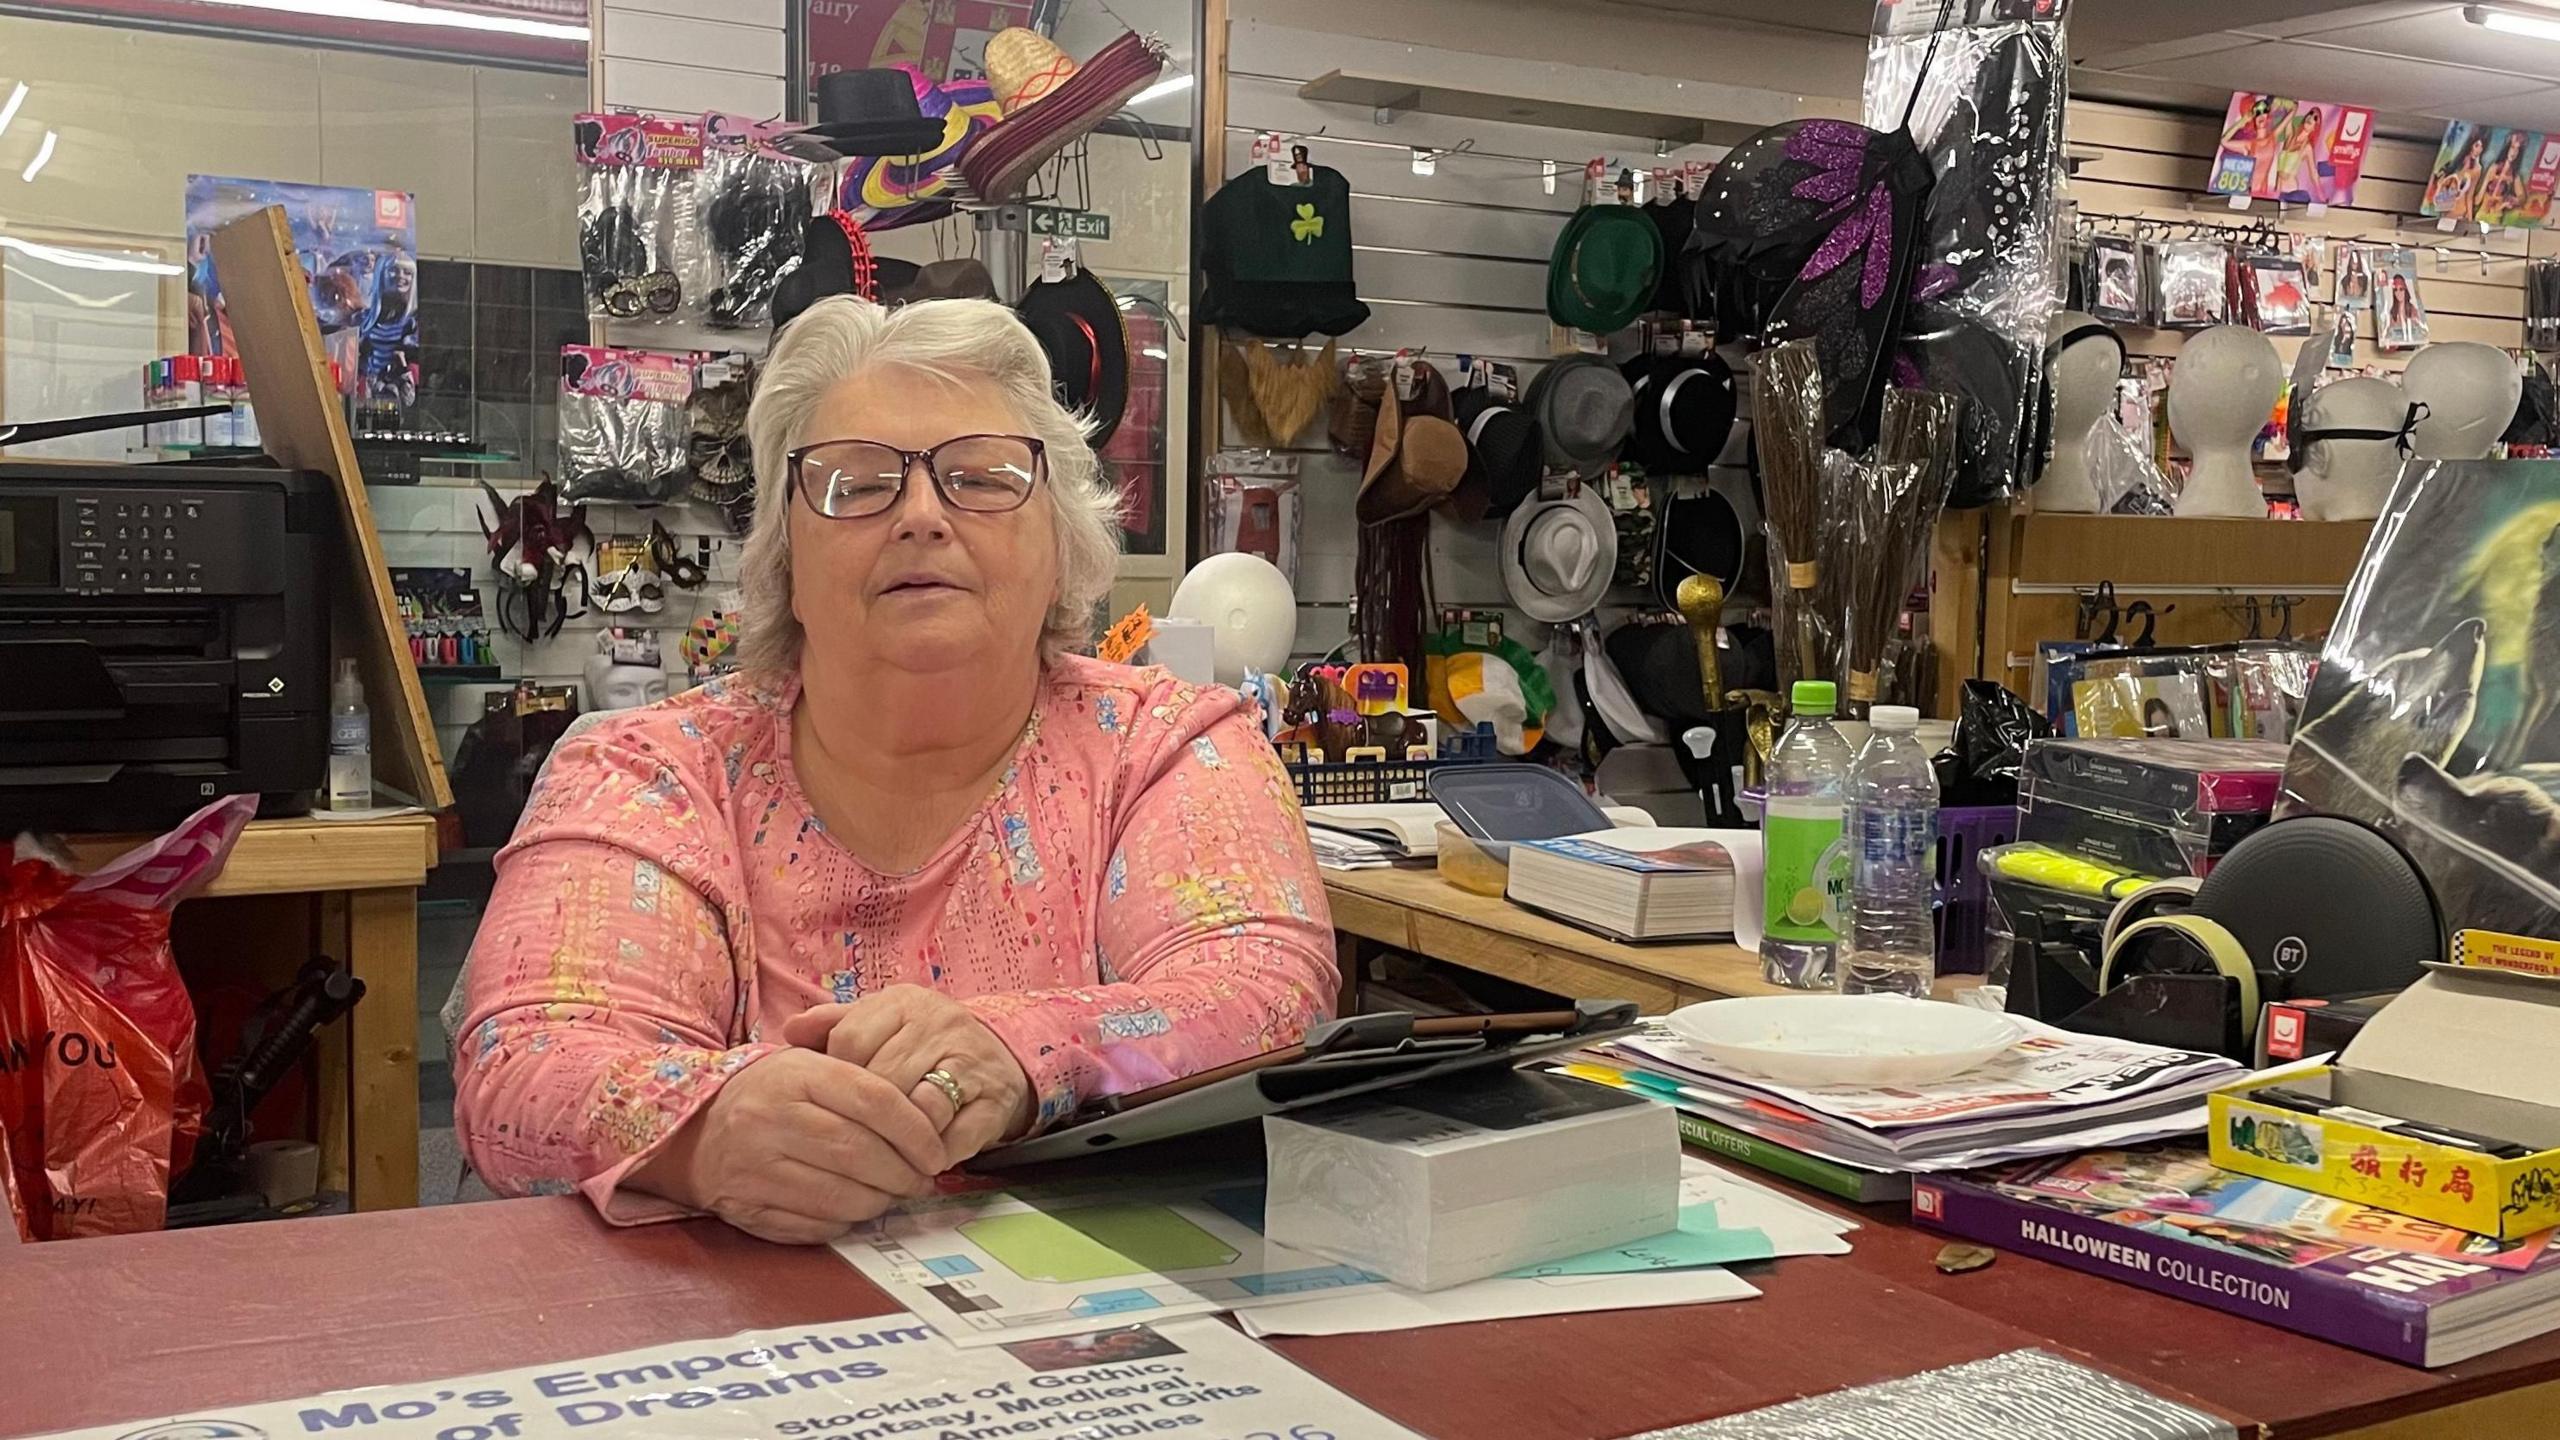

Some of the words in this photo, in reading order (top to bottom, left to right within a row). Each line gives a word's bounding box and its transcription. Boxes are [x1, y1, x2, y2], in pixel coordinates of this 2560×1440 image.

[647, 135, 699, 147] SUPERIOR
[1076, 217, 1106, 235] Exit
[2281, 947, 2300, 962] BT
[1711, 1130, 1751, 1157] OFFERS
[2021, 1219, 2150, 1272] HALLOWEEN
[2157, 1256, 2290, 1310] COLLECTION
[298, 1390, 513, 1432] Mo's
[534, 1325, 930, 1398] Emporium
[436, 1413, 523, 1440] of
[556, 1362, 888, 1427] Dreams
[775, 1391, 968, 1435] Stockist
[973, 1381, 1014, 1398] of
[1029, 1363, 1184, 1388] Gothic,
[797, 1410, 992, 1440] antasy,
[997, 1376, 1206, 1414] Medieval,
[937, 1402, 1153, 1440] American
[1160, 1385, 1262, 1407] Gifts
